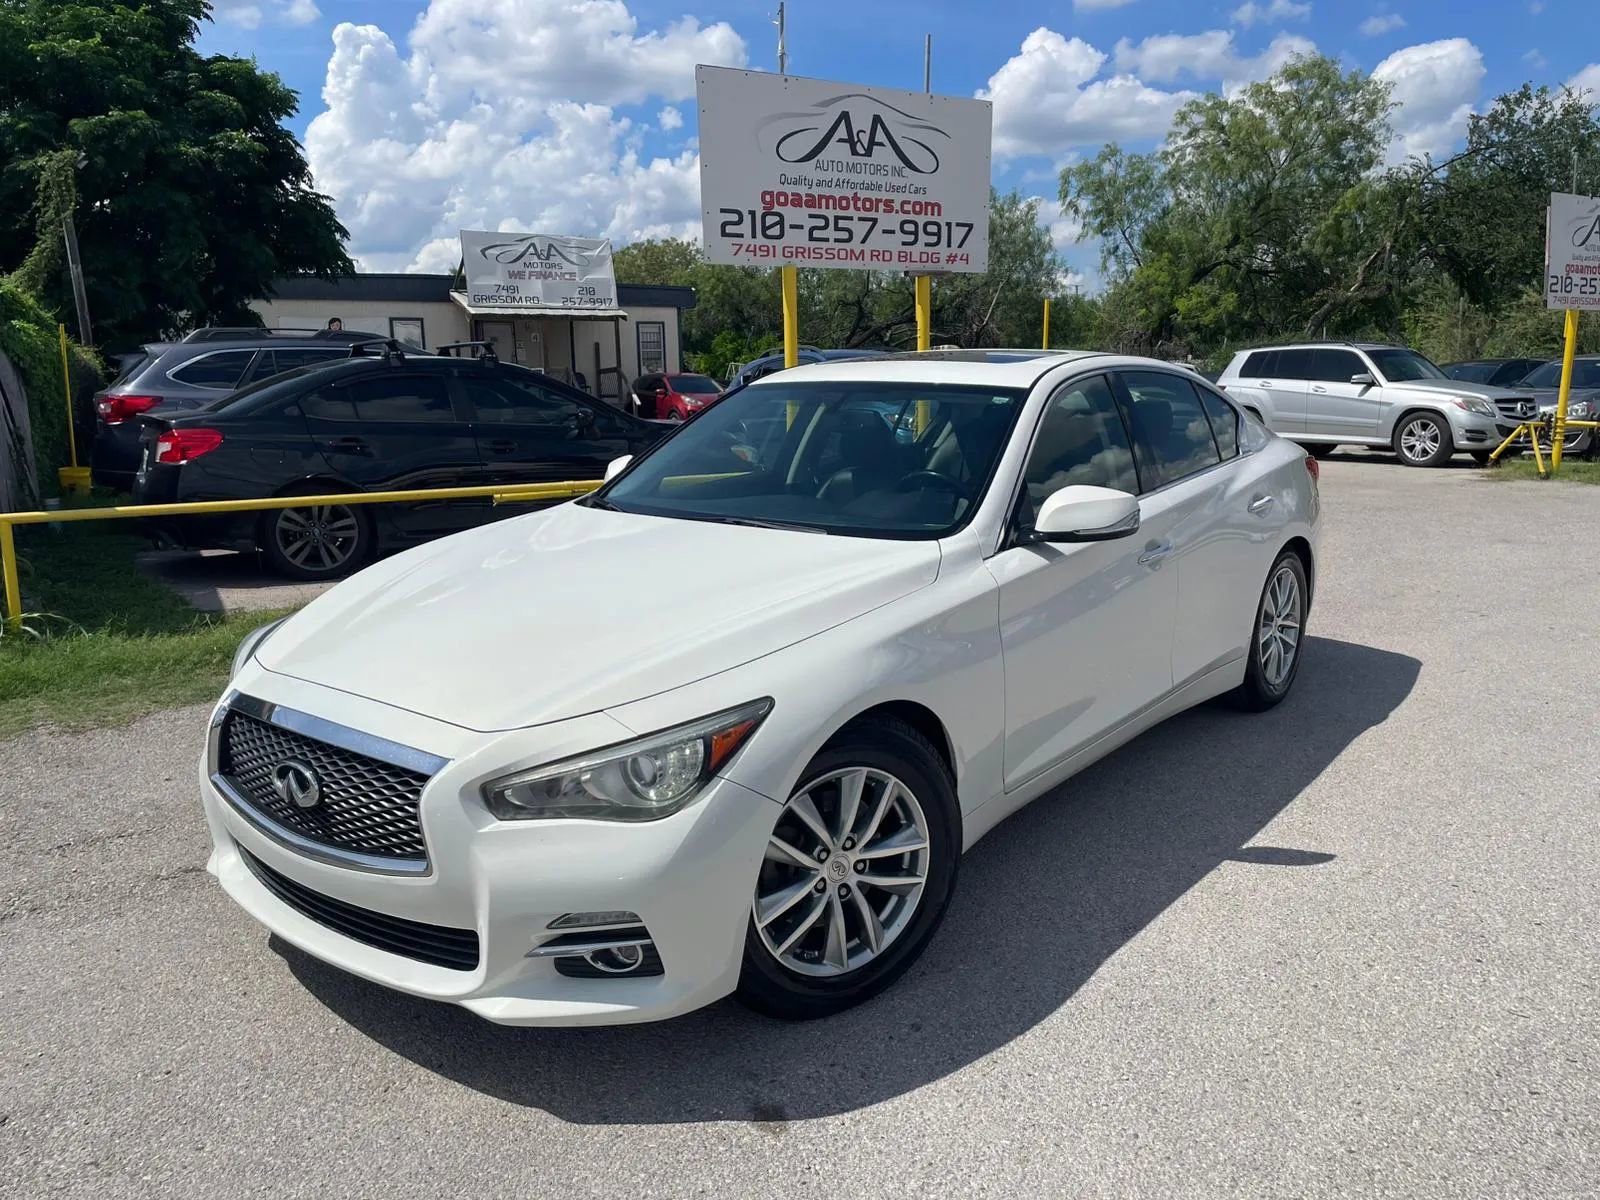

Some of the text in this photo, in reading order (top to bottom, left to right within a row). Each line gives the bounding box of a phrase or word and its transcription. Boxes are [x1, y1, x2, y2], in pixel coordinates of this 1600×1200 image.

[815, 159, 843, 173] AUTO
[846, 162, 889, 176] MOTORS
[779, 173, 927, 195] Quality and Affordable Used Cars
[761, 189, 942, 216] goaamotors.com
[719, 207, 974, 249] 210-257-9917
[731, 243, 970, 265] 7491 GRISSOM RD BLDG #4
[523, 261, 564, 270] MOTORS
[507, 270, 577, 281] WE FINANCE
[494, 284, 520, 294] 7491
[577, 286, 596, 296] 210
[1549, 275, 1600, 295] 210-25
[473, 294, 523, 304] GRISSOM
[561, 296, 613, 306] 257-9917
